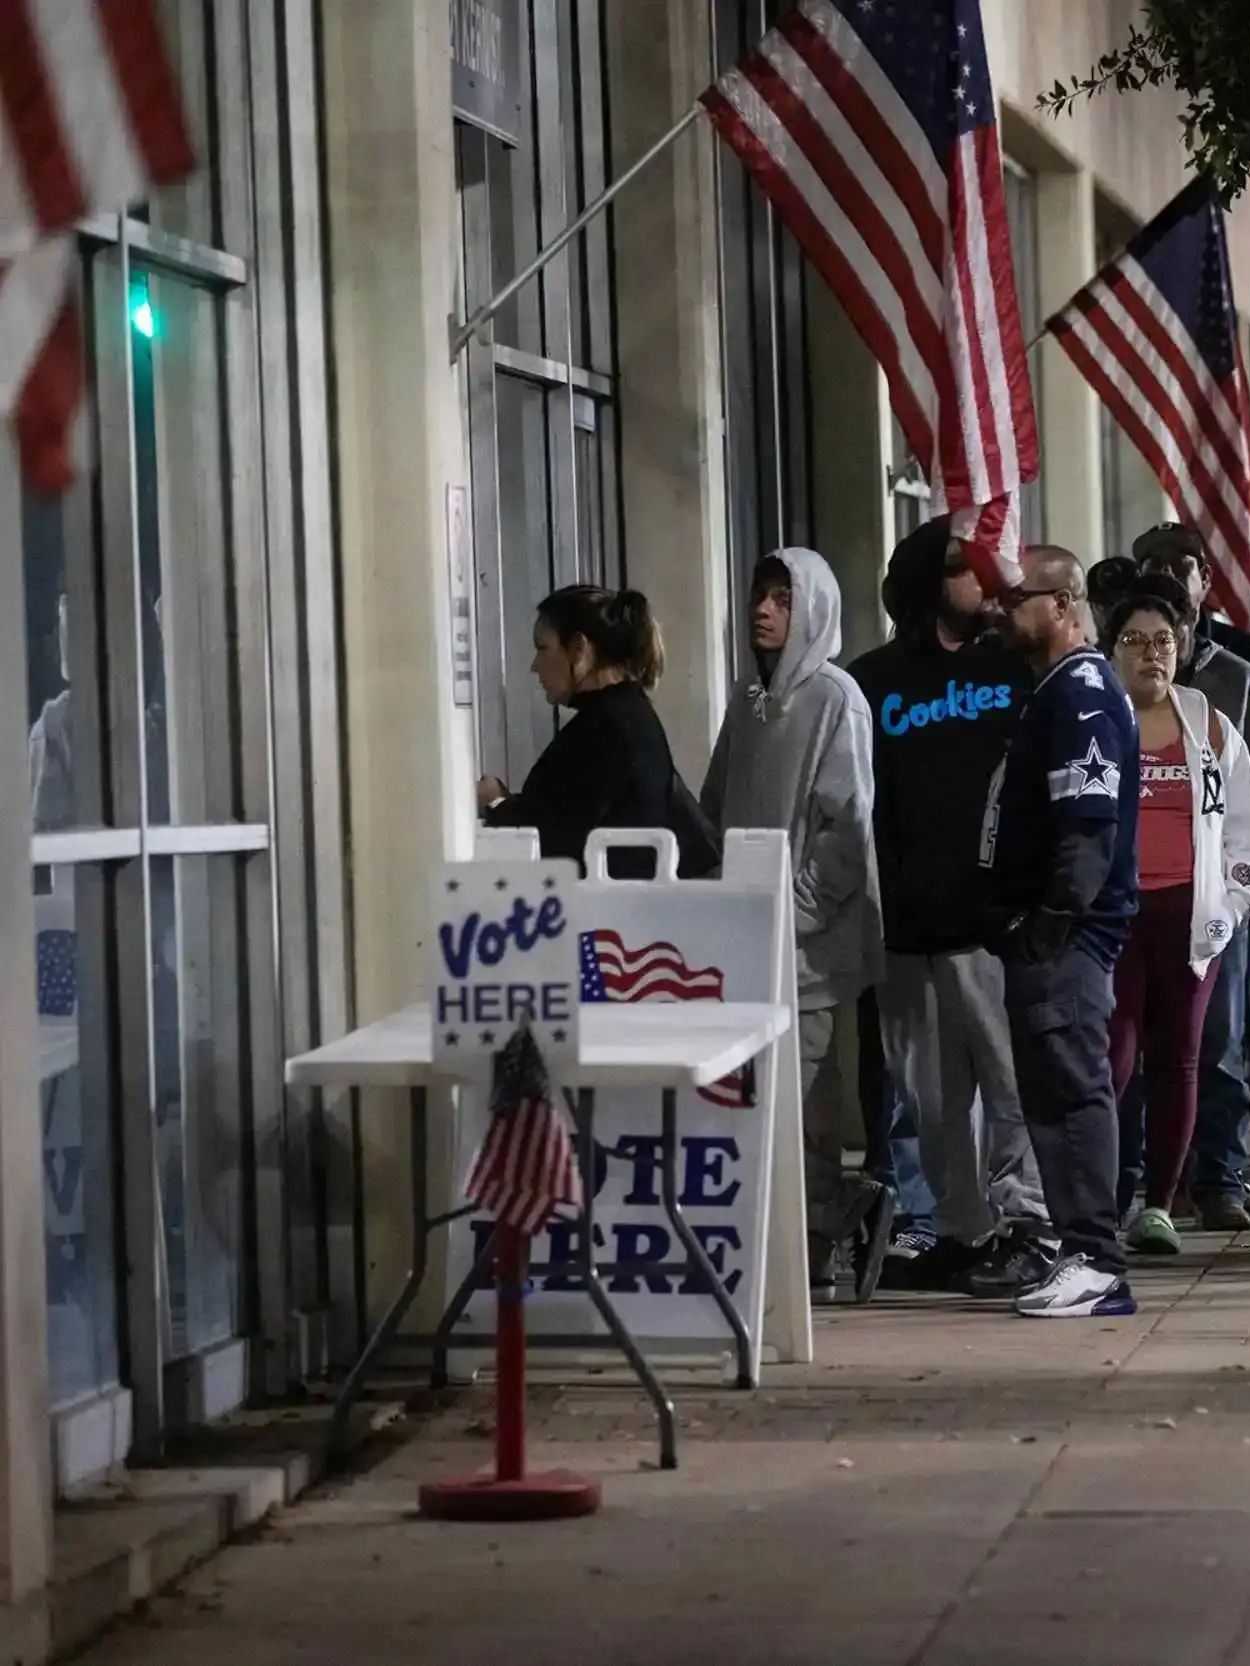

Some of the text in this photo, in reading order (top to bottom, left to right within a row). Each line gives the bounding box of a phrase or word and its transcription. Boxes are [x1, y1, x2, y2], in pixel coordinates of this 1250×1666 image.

[881, 680, 1012, 736] Cookies
[439, 895, 566, 978] Vote
[438, 983, 570, 1022] HERE
